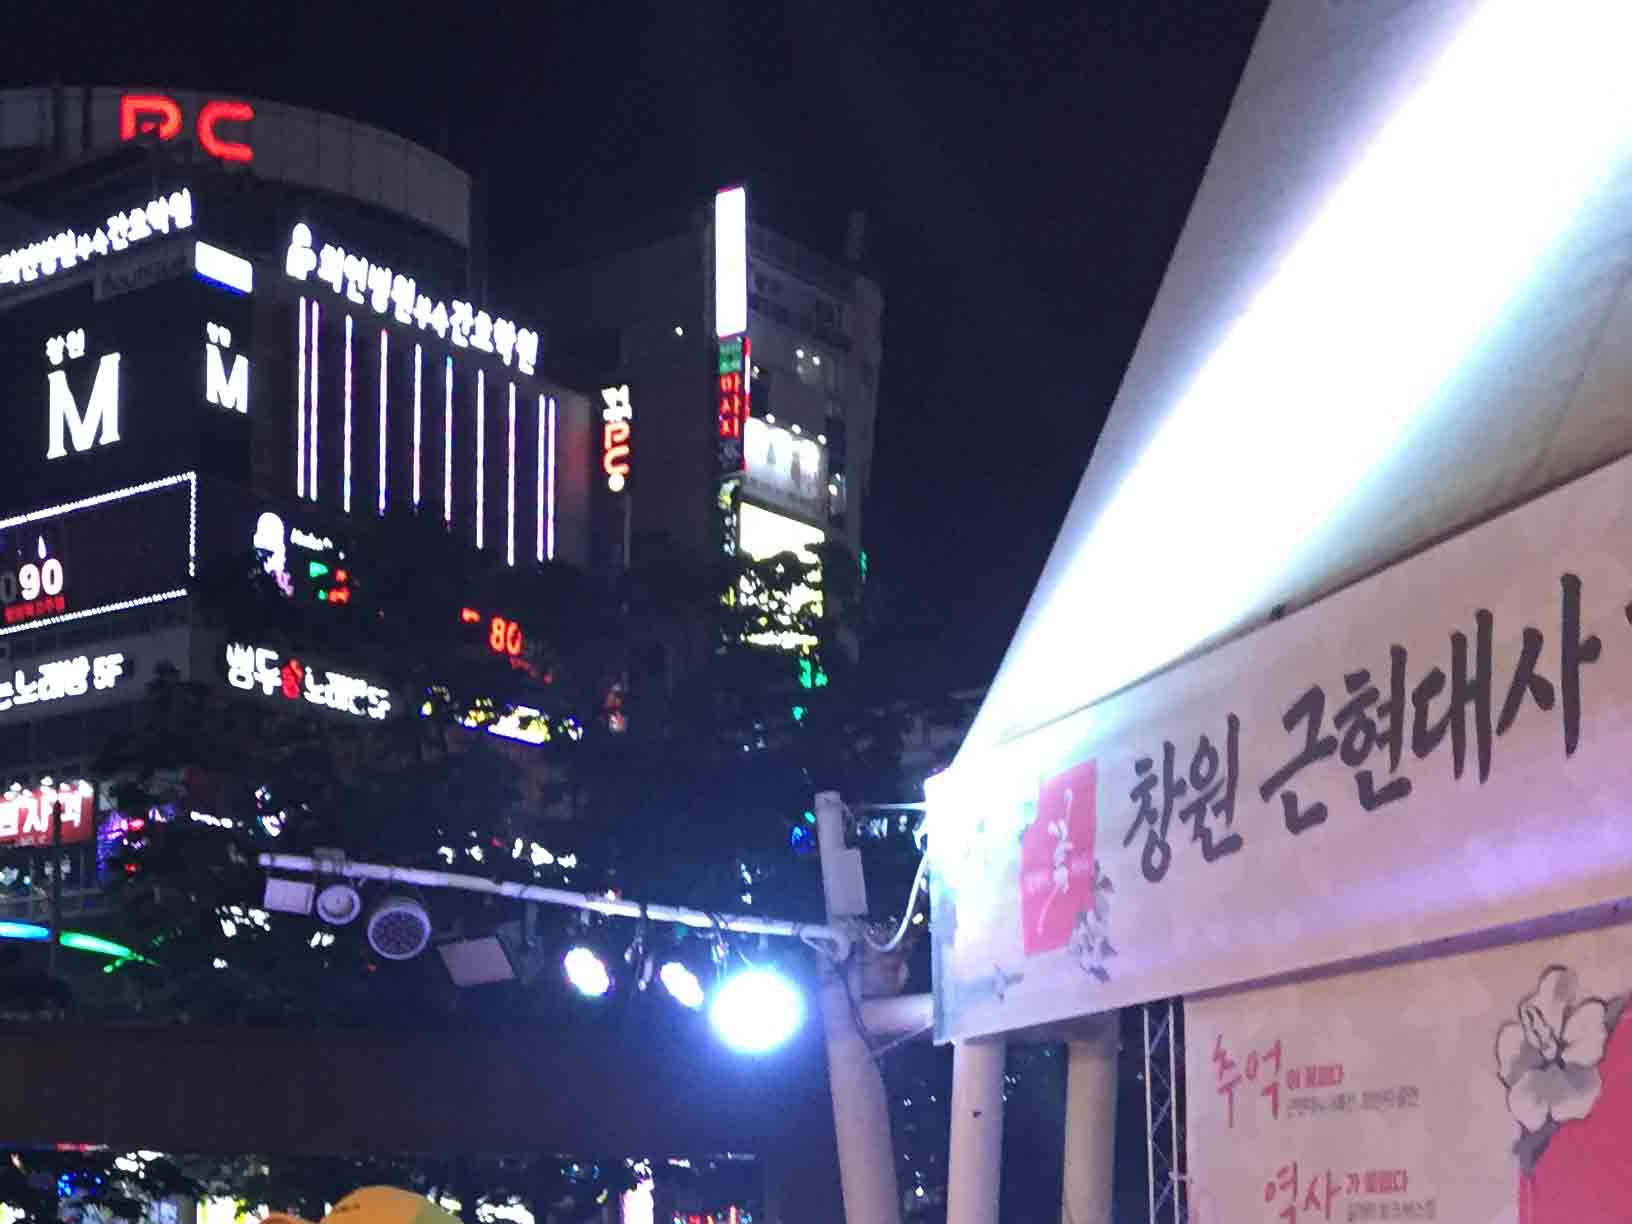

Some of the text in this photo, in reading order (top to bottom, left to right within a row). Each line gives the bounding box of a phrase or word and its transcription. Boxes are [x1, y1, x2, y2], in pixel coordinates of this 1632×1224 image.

[47, 352, 121, 459] M
[206, 343, 249, 413] M
[1123, 573, 1603, 884] 창원 근현대사
